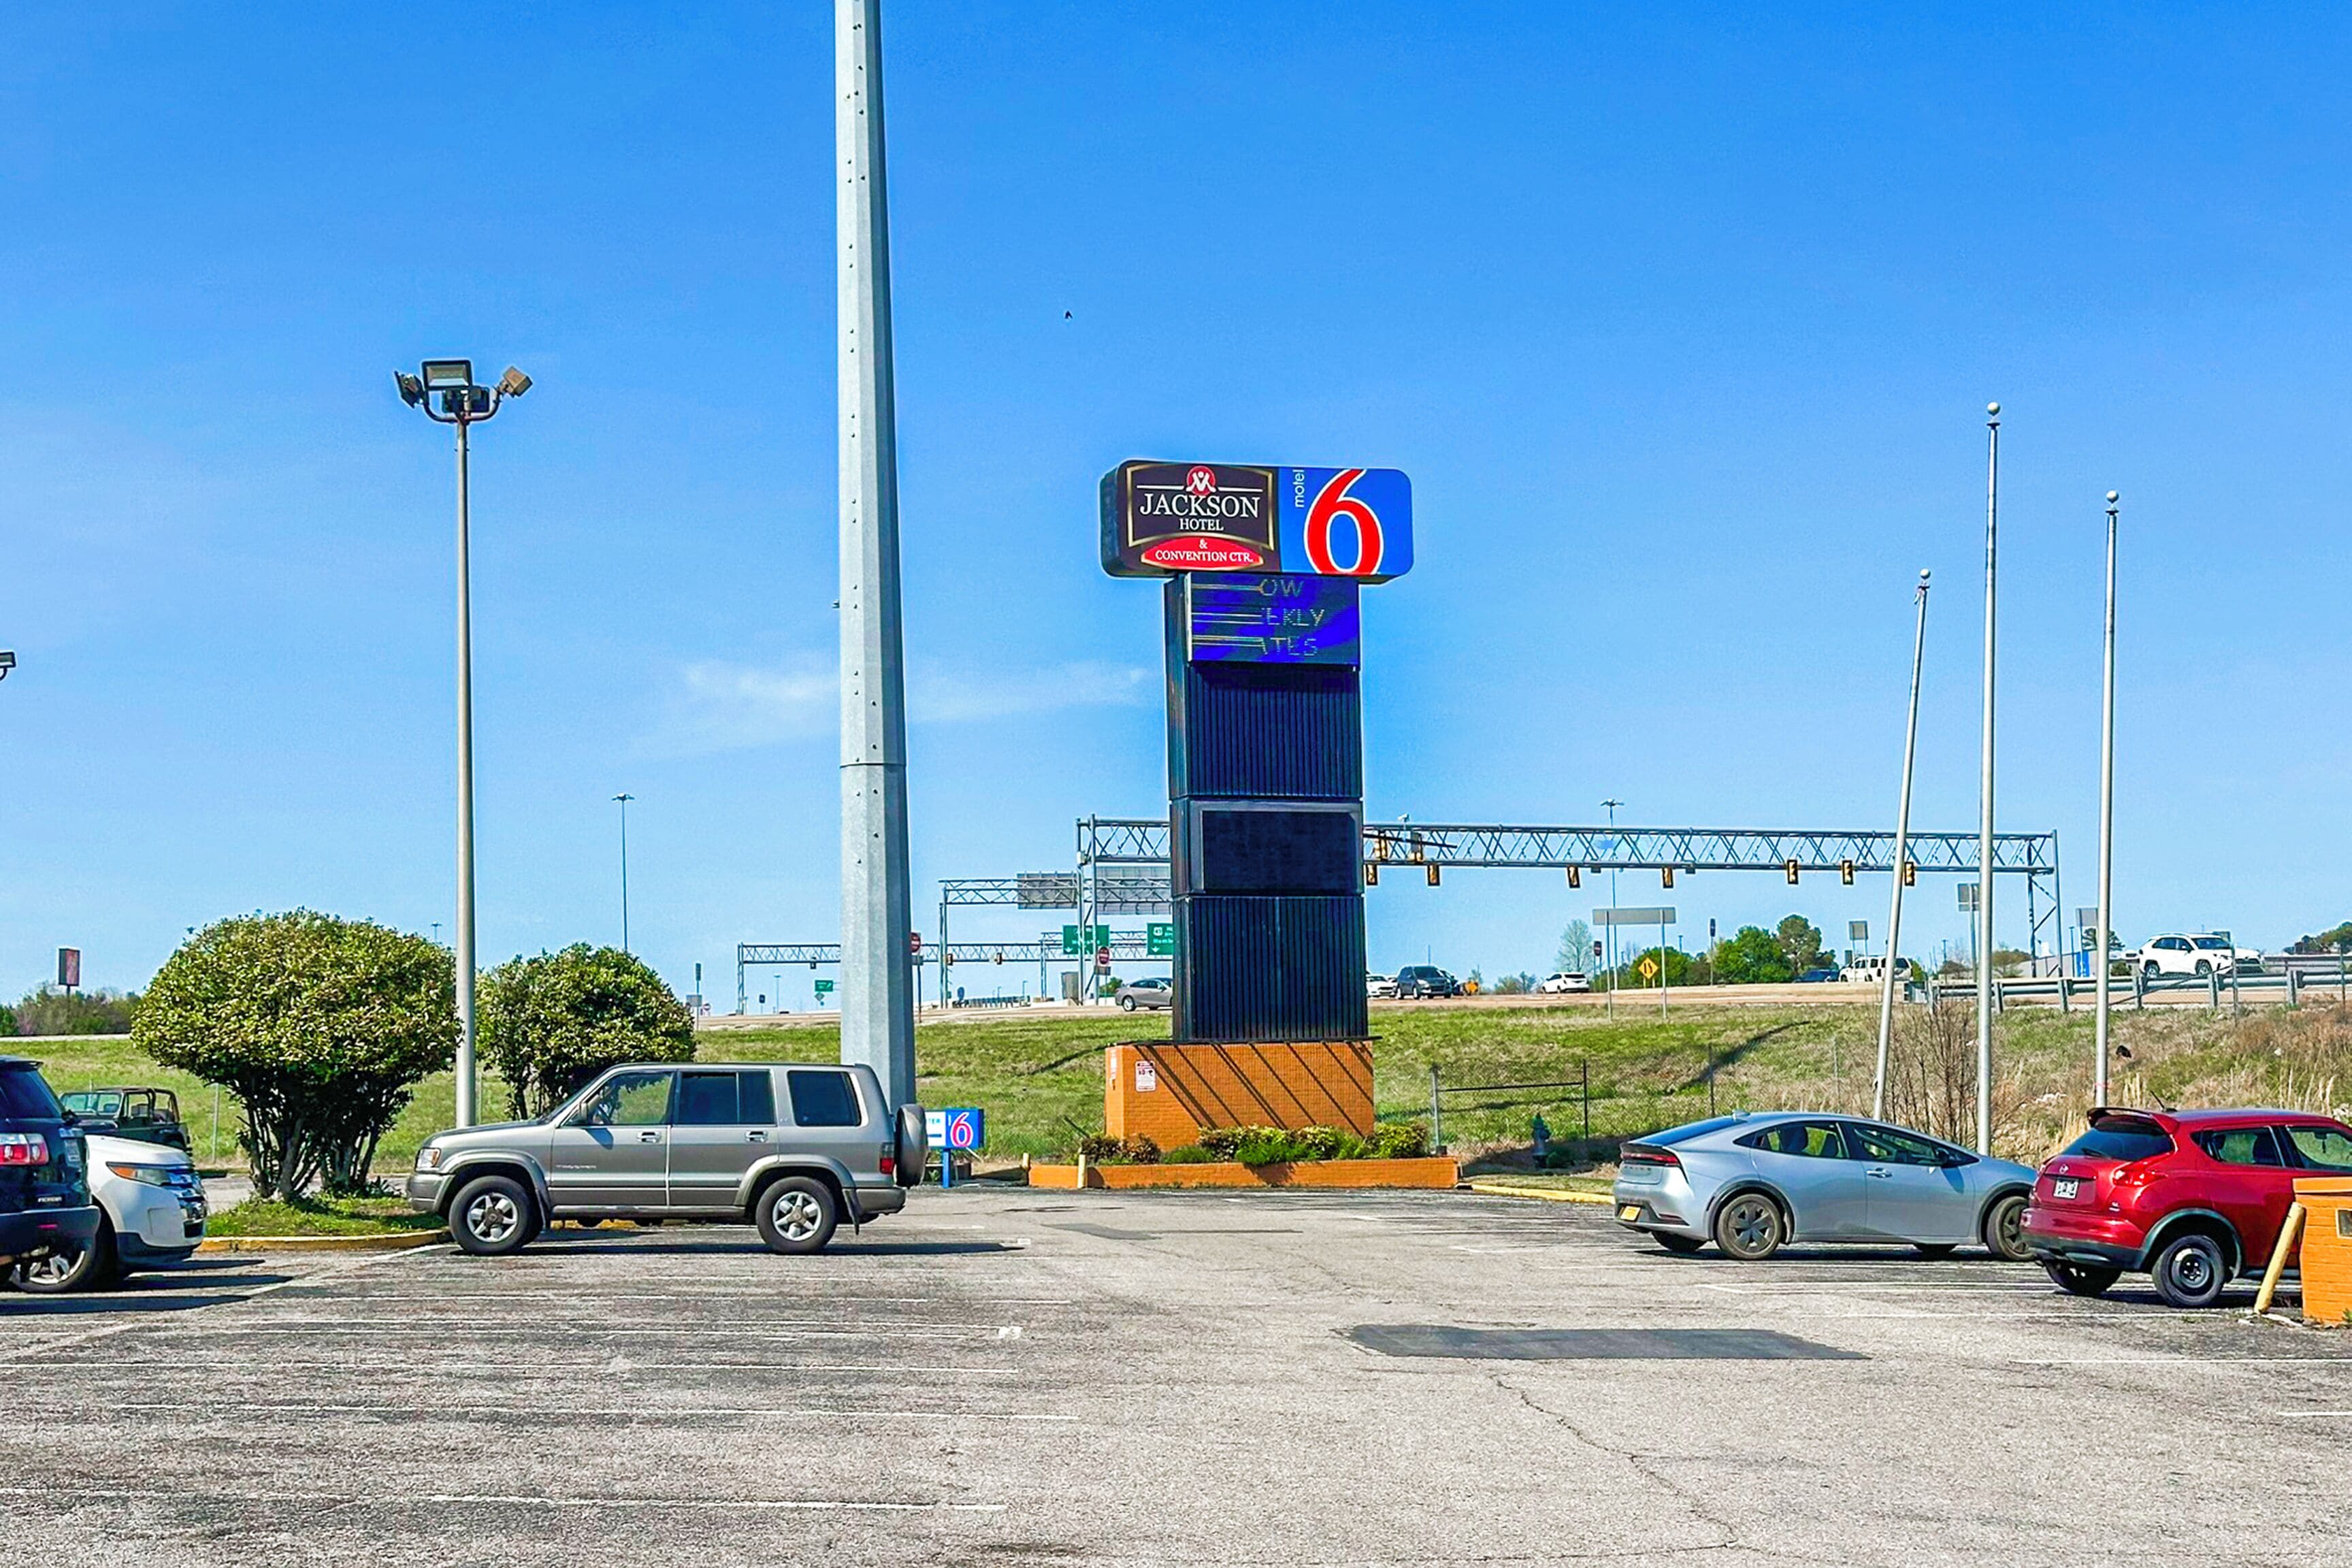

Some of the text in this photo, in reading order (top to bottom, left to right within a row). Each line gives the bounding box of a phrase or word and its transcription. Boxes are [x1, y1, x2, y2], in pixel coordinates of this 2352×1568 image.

[1292, 469, 1305, 508] motel
[1140, 493, 1260, 518] JACKSON
[1179, 519, 1224, 531] HOTEL
[1303, 468, 1384, 574] 6
[1198, 538, 1208, 549] &
[1155, 550, 1254, 563] CONVENTION CTR.
[950, 1111, 973, 1147] 6
